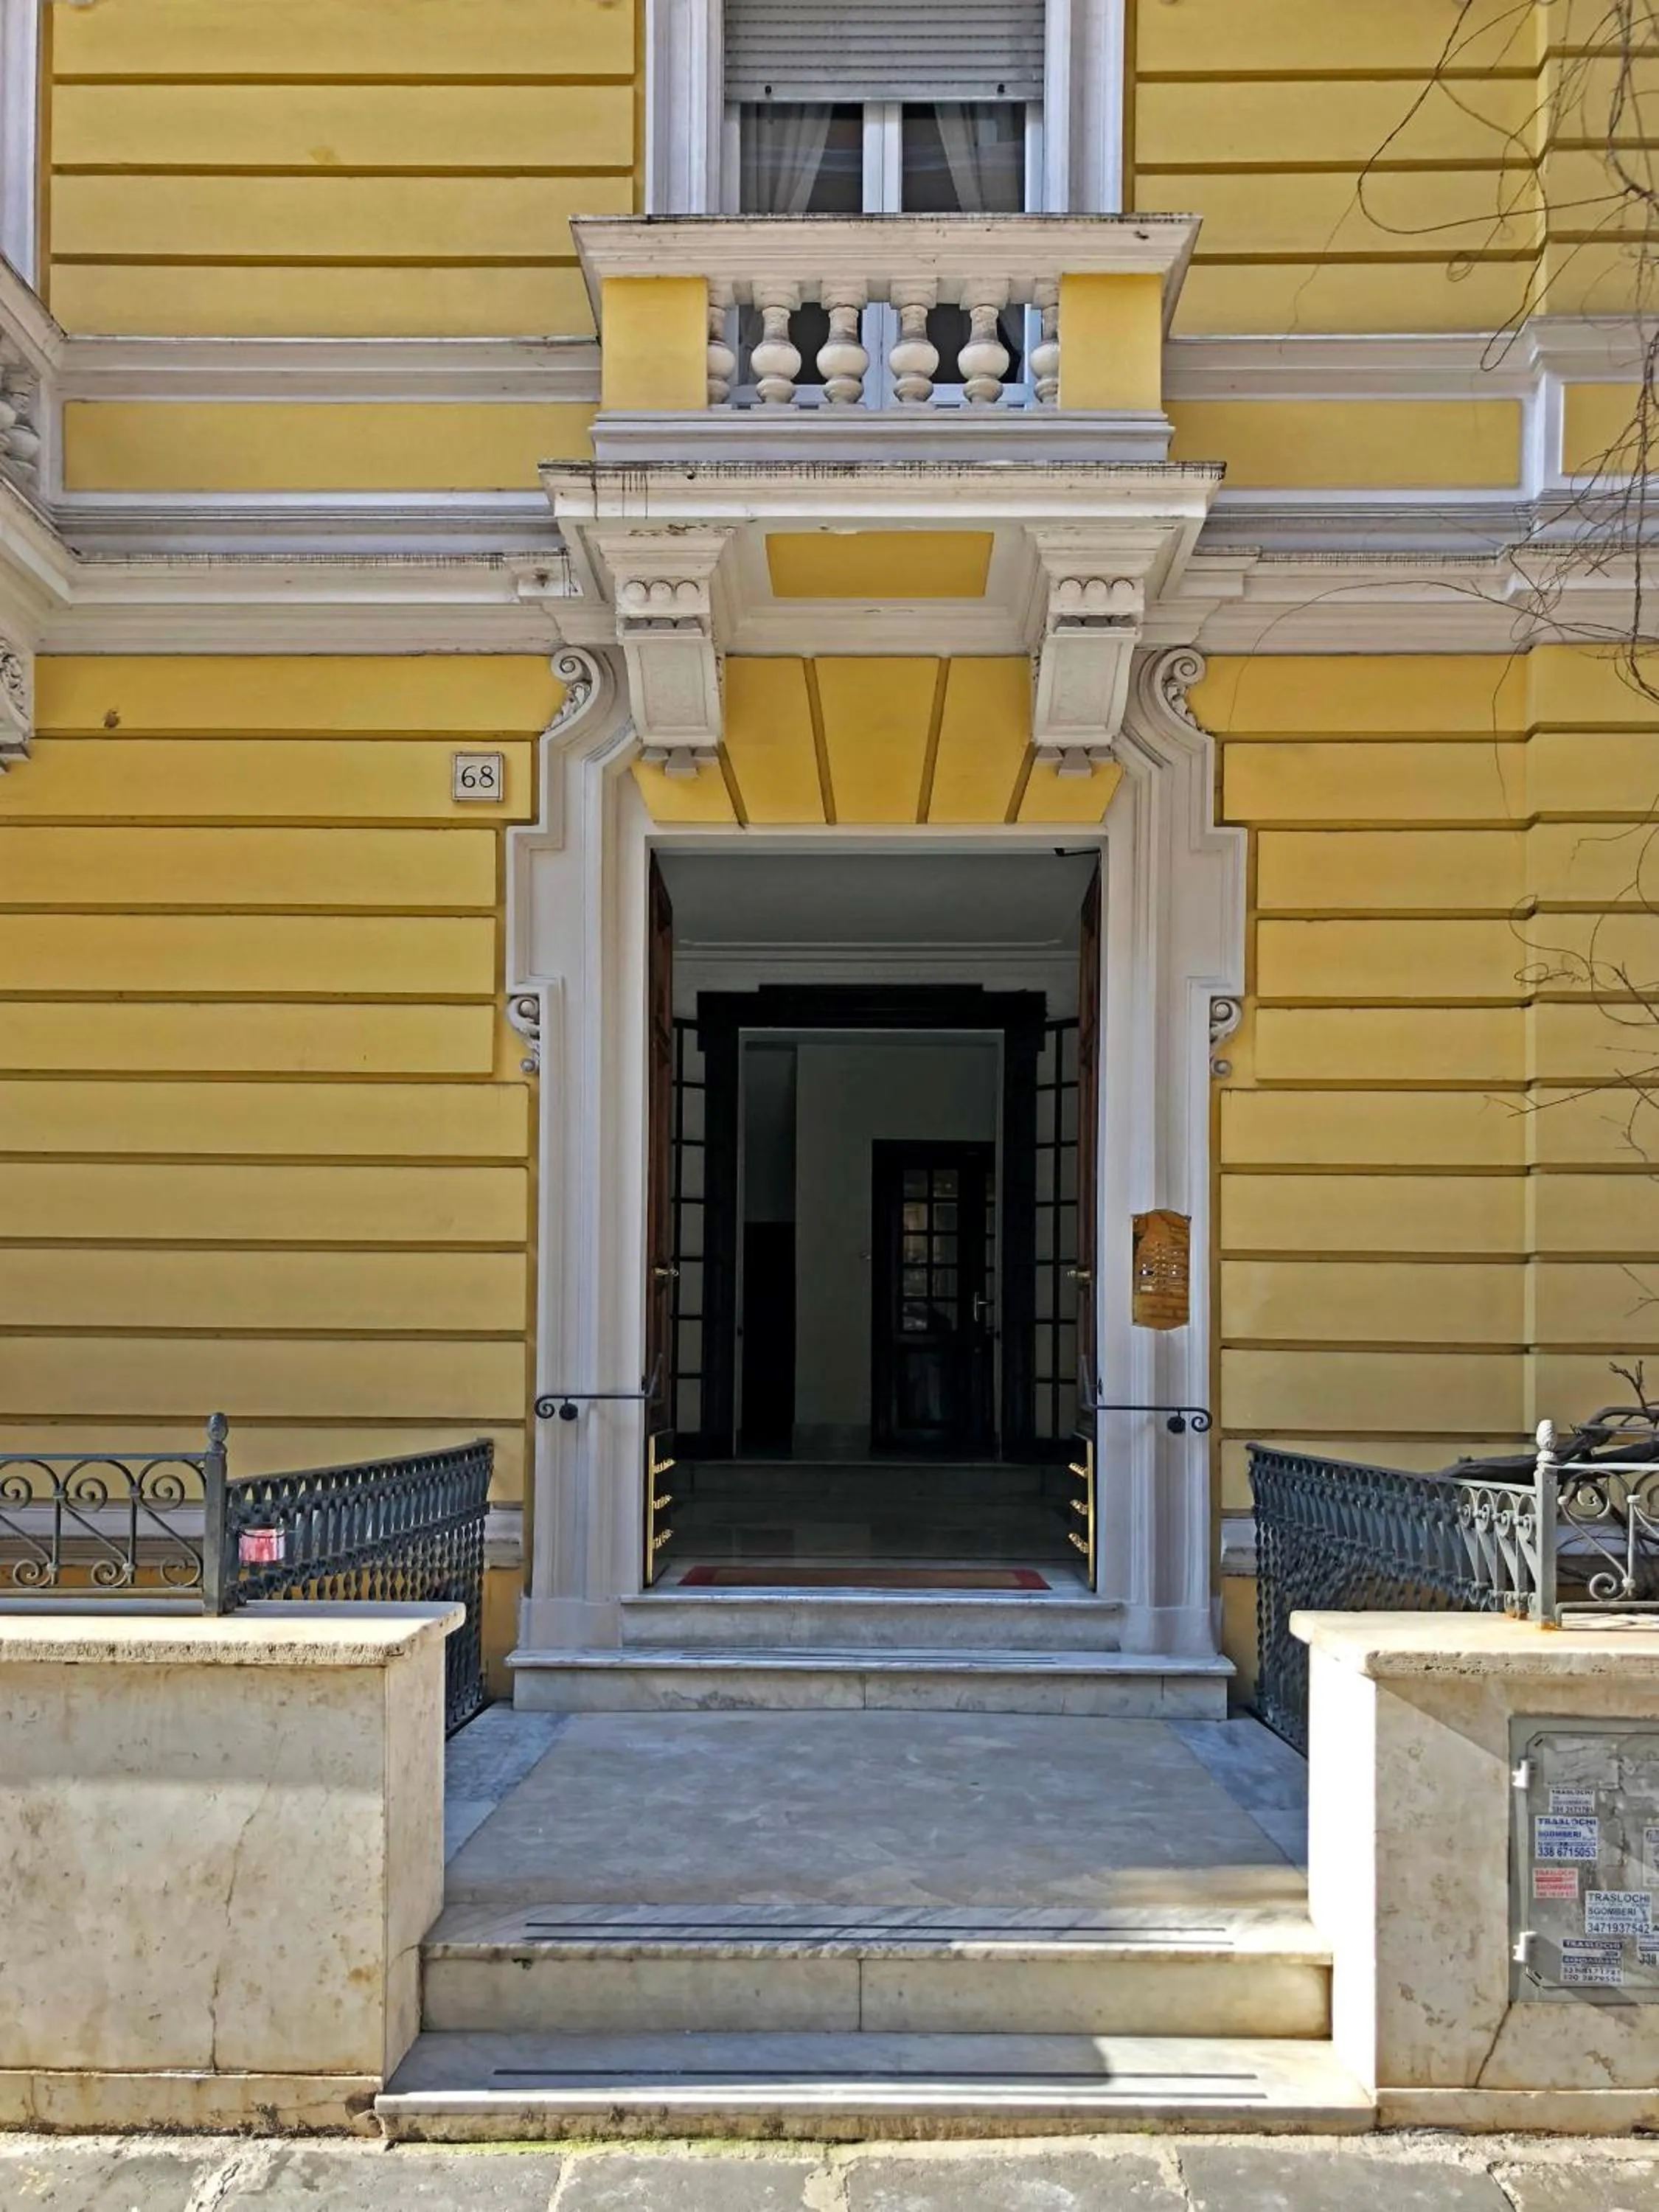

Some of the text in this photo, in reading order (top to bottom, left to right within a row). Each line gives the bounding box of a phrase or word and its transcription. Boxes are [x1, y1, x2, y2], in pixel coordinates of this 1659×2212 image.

[462, 765, 494, 788] 68
[1588, 1893, 1650, 1903] TRASLOCHI
[1588, 1907, 1636, 1916] SGOMBERI
[1587, 1922, 1649, 1934] 3471937542
